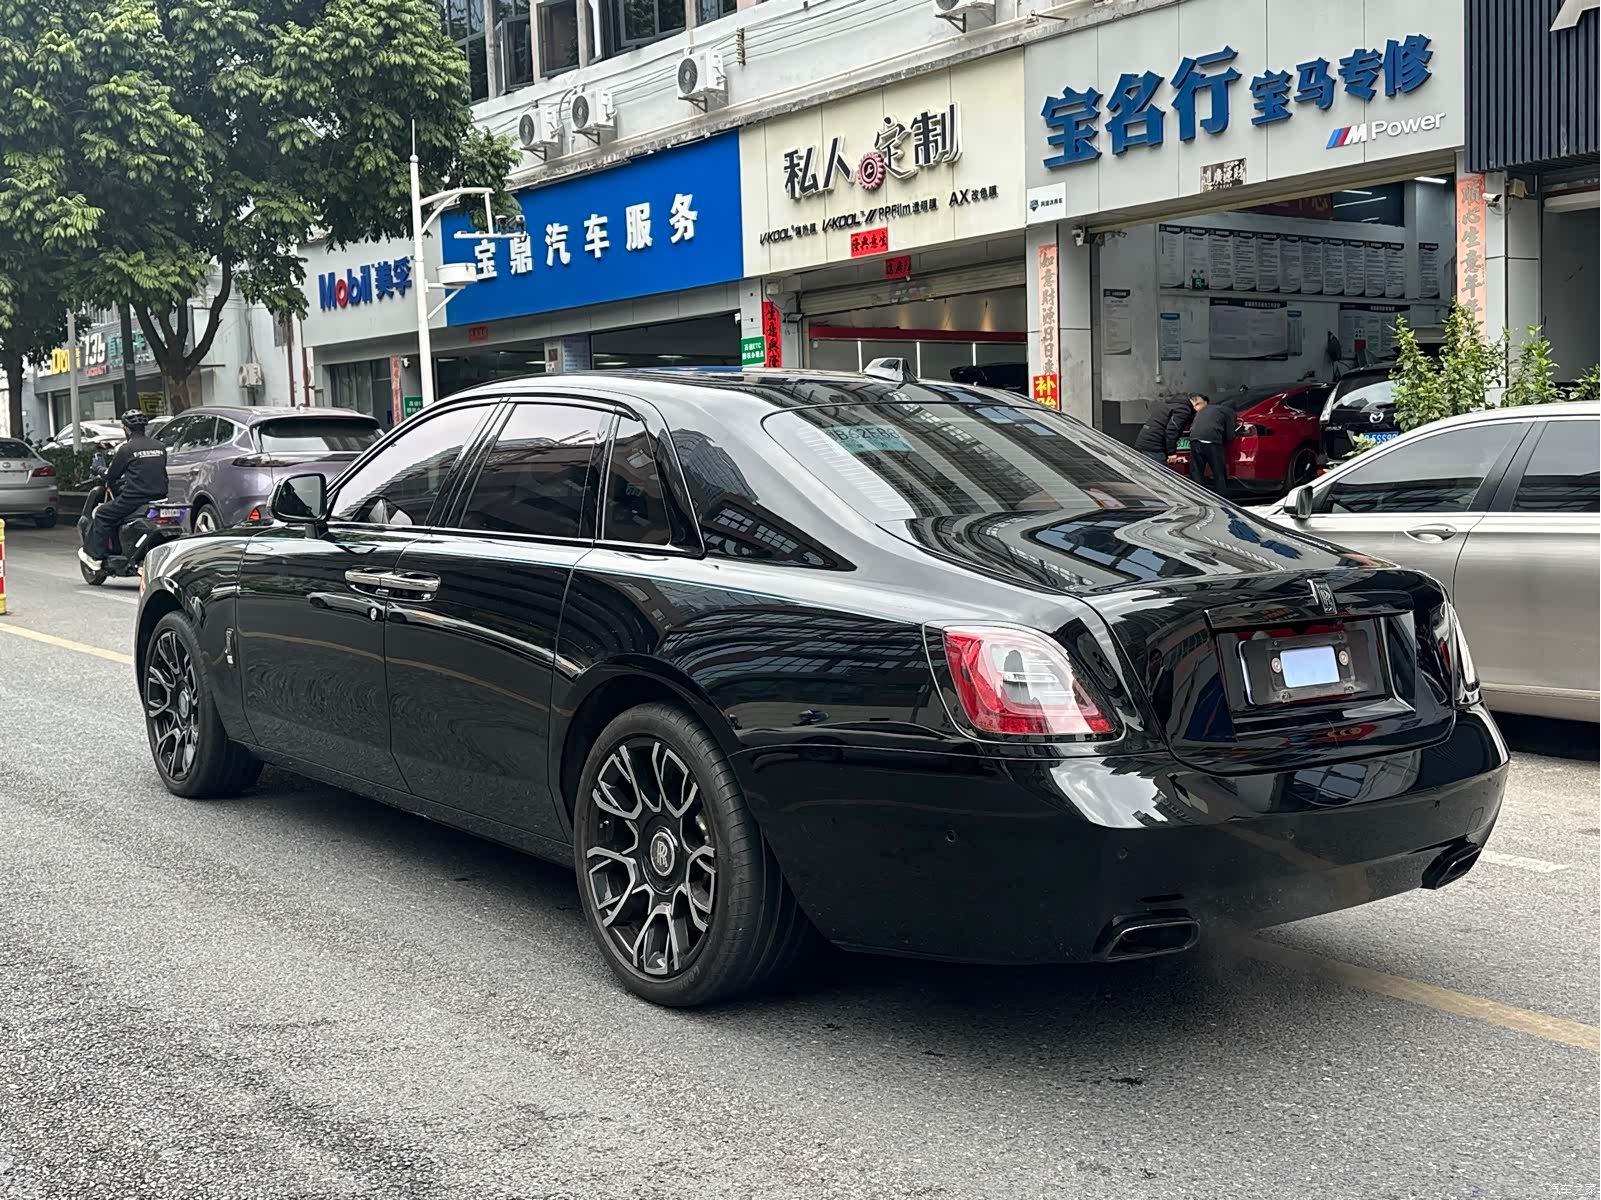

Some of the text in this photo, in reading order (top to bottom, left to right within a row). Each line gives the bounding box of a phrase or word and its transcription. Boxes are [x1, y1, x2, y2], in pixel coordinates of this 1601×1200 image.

[1040, 33, 1434, 169] 宝名行 宝马专修
[1371, 111, 1446, 140] Power
[784, 101, 963, 200] 私人定制
[948, 188, 970, 206] AX
[474, 193, 698, 281] 宝鼎汽车服务
[318, 255, 413, 311] Mobil 美孚
